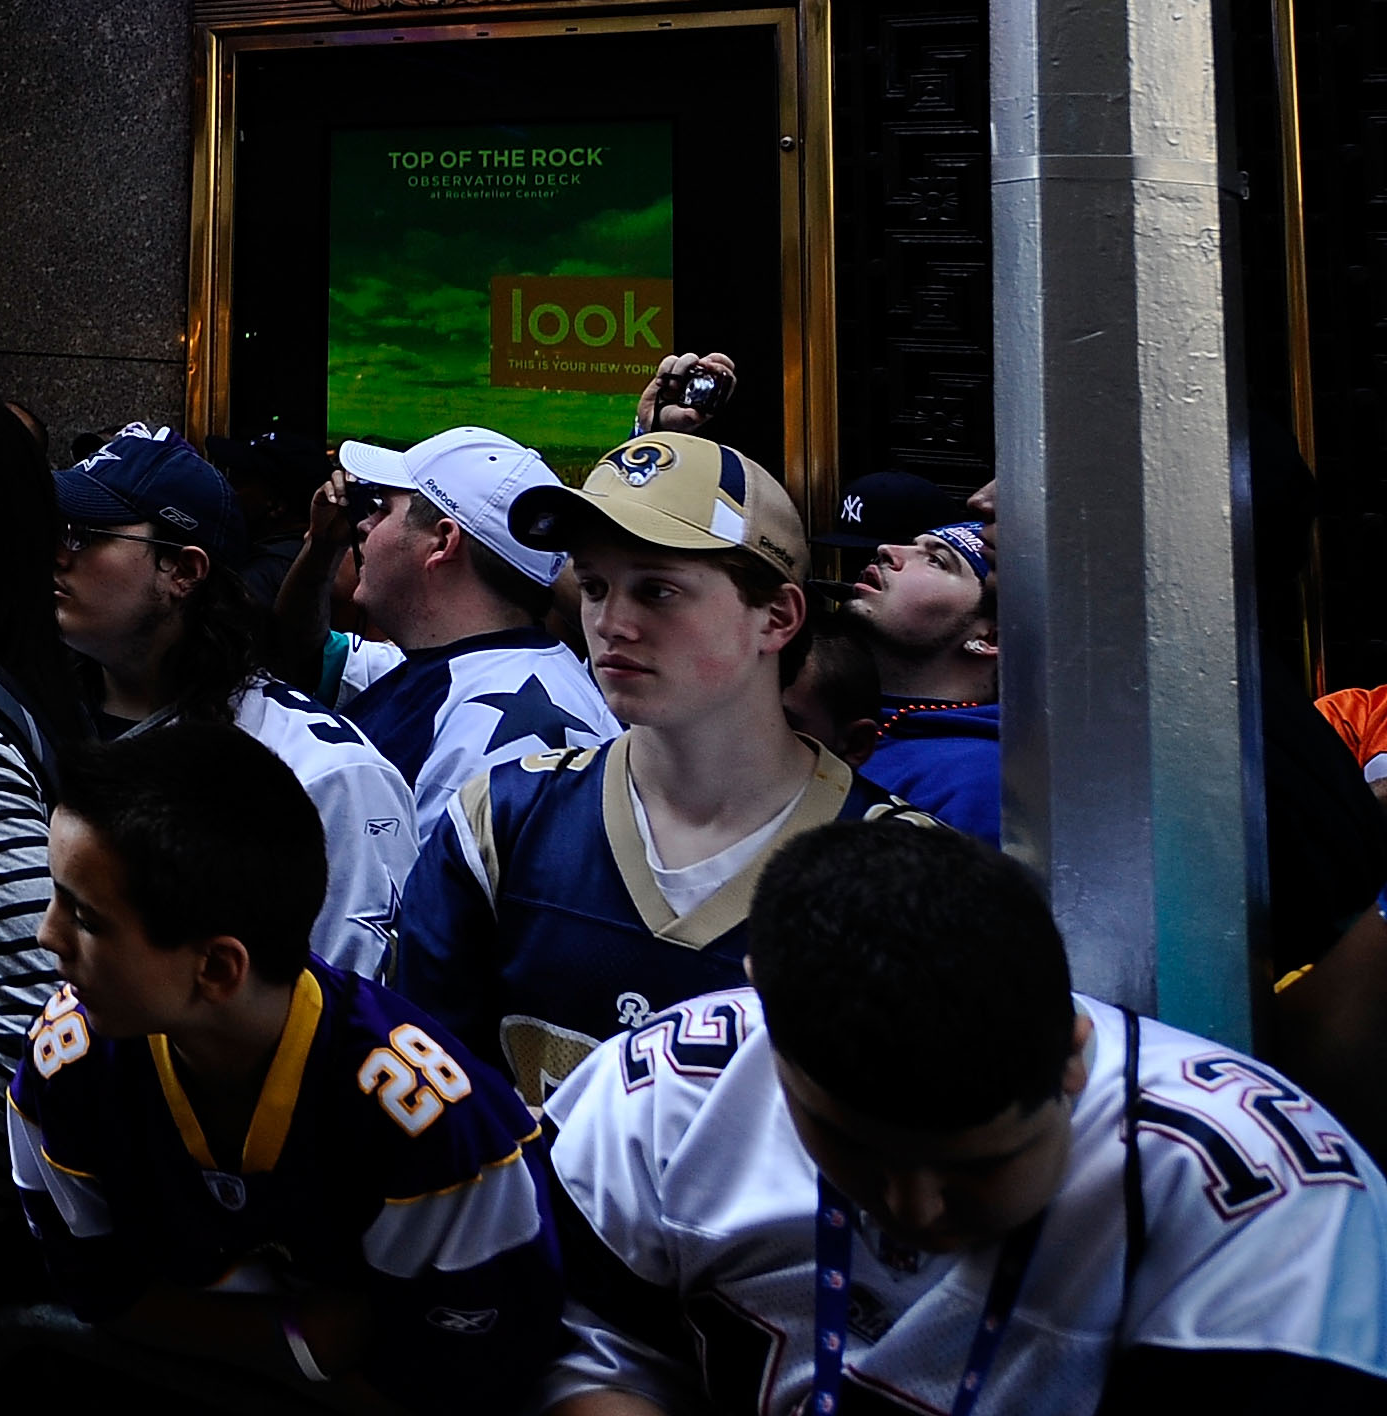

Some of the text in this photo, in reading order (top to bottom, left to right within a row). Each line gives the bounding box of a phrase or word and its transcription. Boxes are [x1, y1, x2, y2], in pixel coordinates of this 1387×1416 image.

[388, 147, 604, 170] TOP OF THE ROCK
[408, 173, 581, 187] OBSERVATION DECK
[512, 288, 662, 348] look
[508, 359, 658, 376] THIS IS YOUR NEW YORK
[425, 478, 459, 512] Reebok
[840, 494, 864, 524] NY
[356, 1022, 473, 1139] 28
[1132, 1050, 1365, 1222] 12
